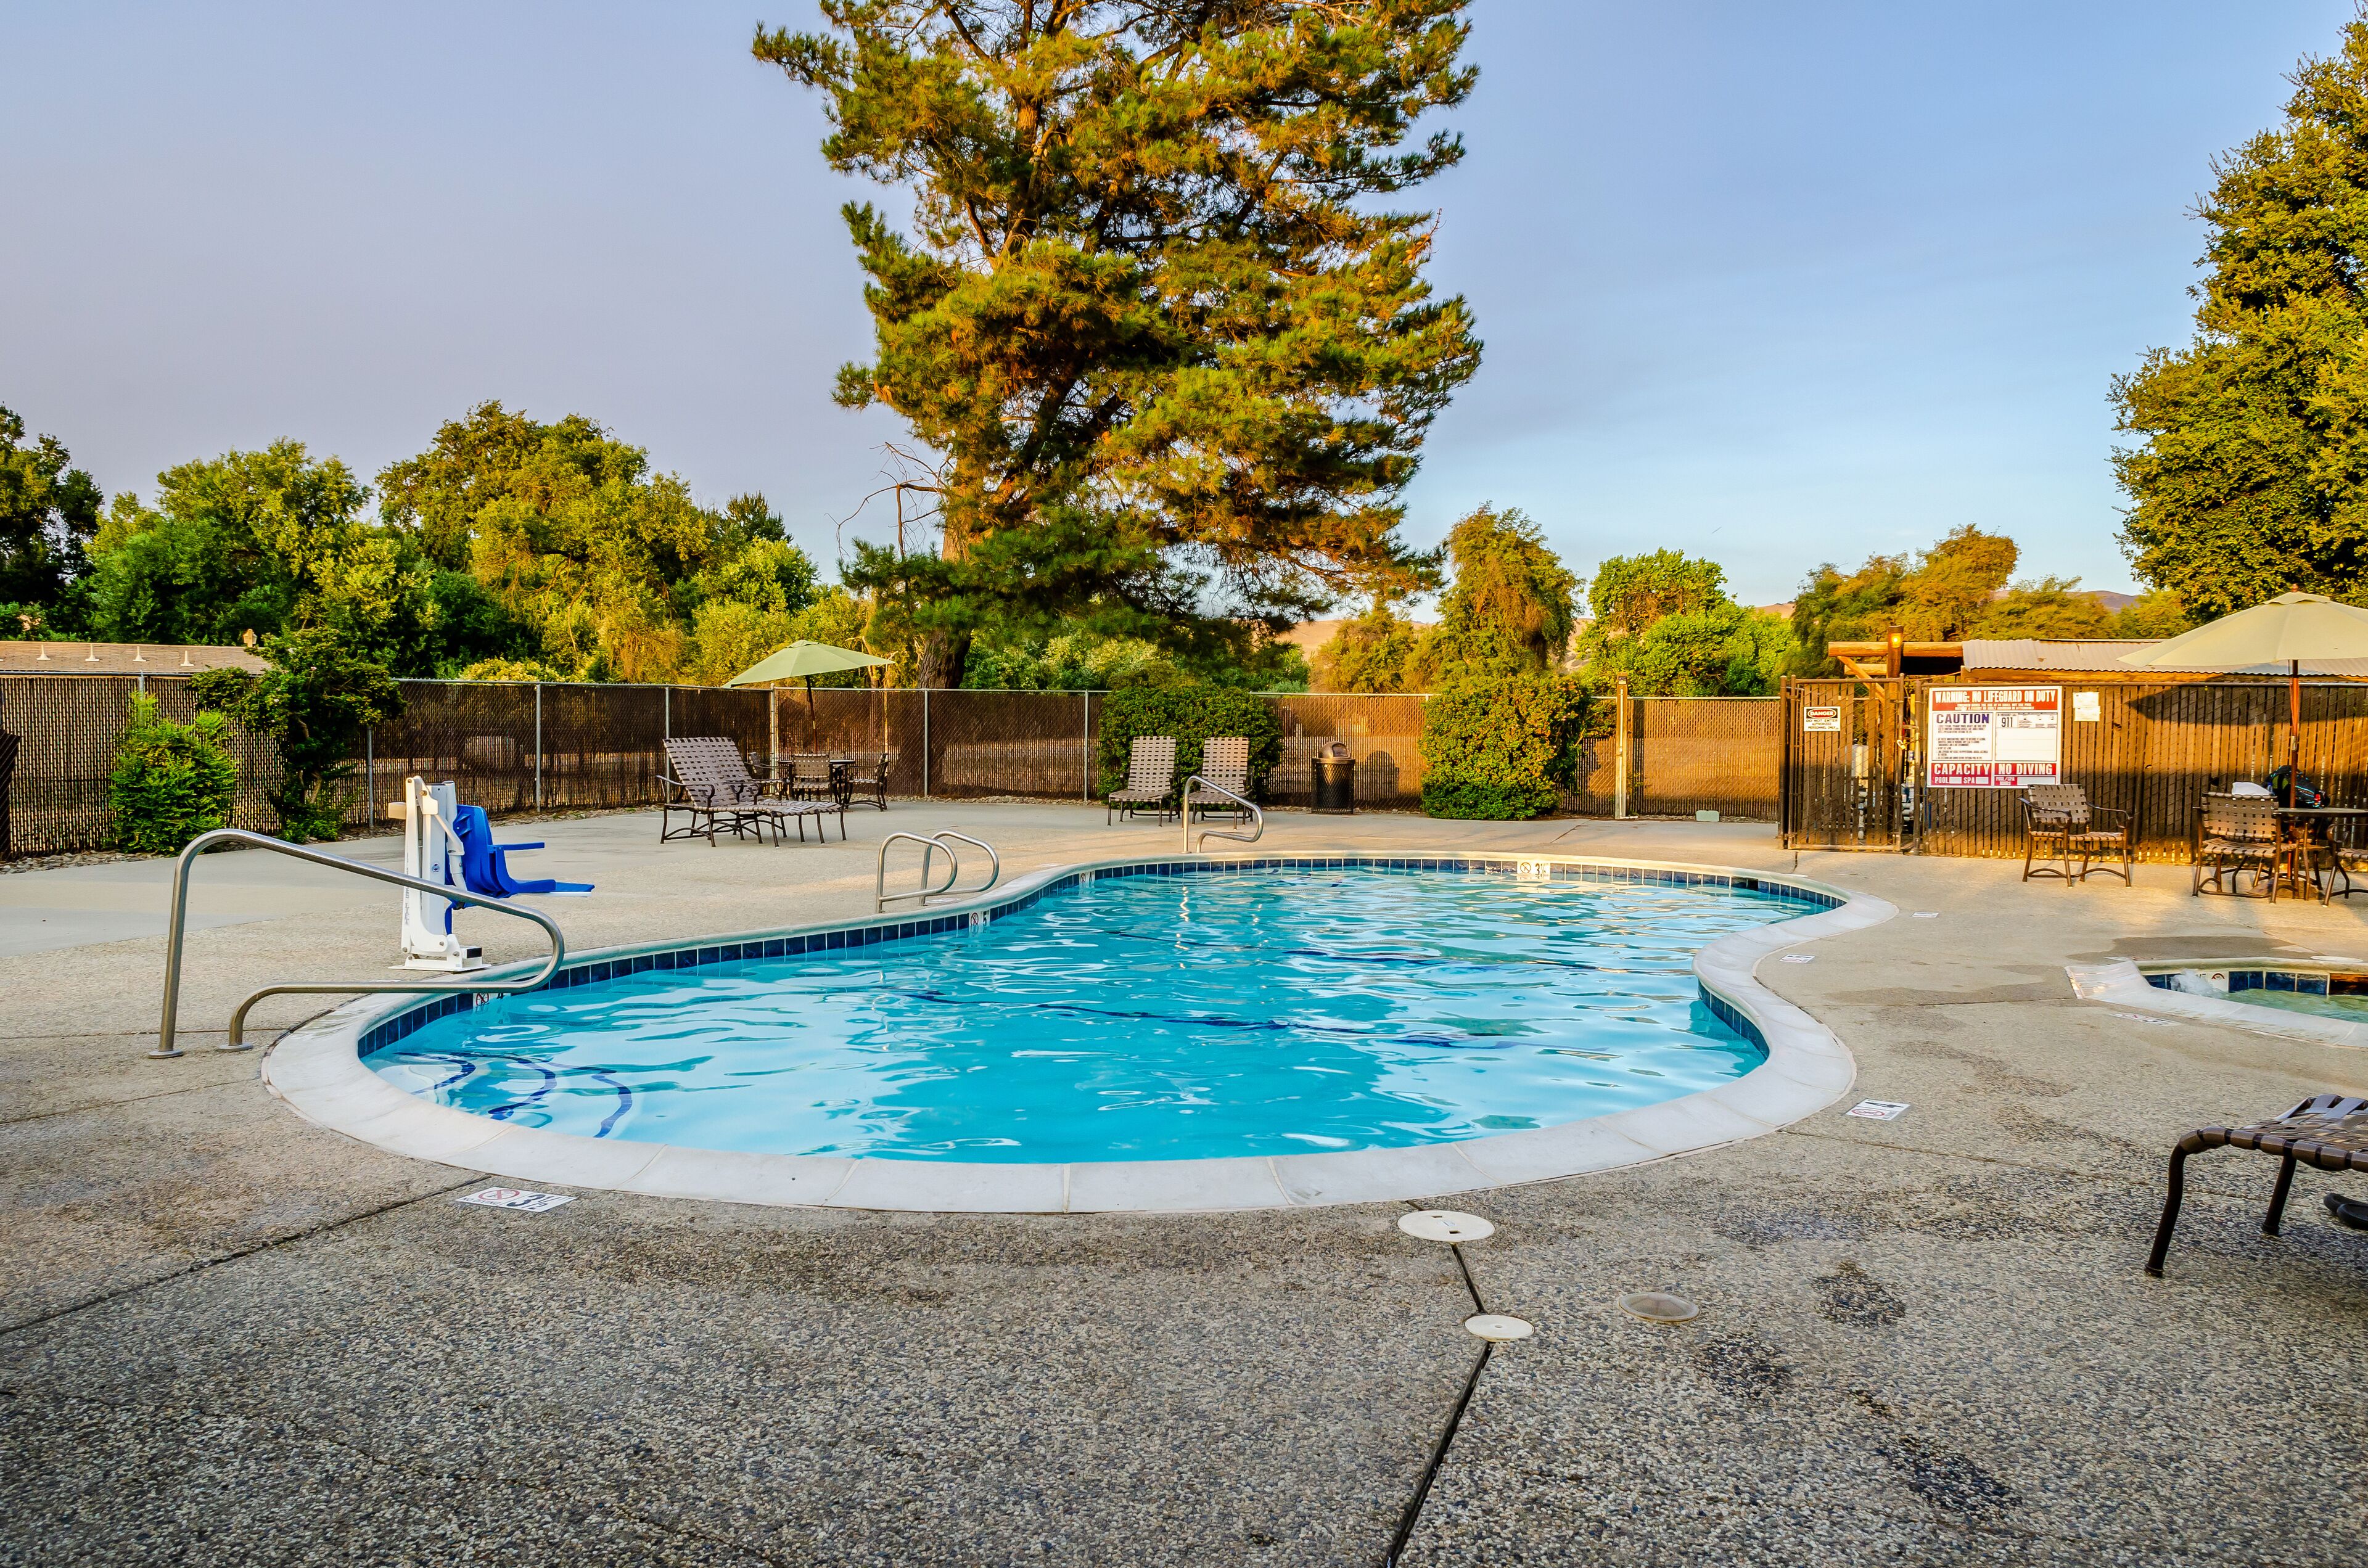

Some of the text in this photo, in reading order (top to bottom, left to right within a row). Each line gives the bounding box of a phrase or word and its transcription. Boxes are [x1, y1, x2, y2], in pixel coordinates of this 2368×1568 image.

[1935, 690, 2056, 703] WARNING: NO LIFEGUARD ON DUTY
[1936, 713, 1989, 724] CAUTION
[2001, 717, 2013, 727] 911
[1934, 763, 1991, 775] CAPACITY
[1998, 763, 2052, 775] NO DIVING
